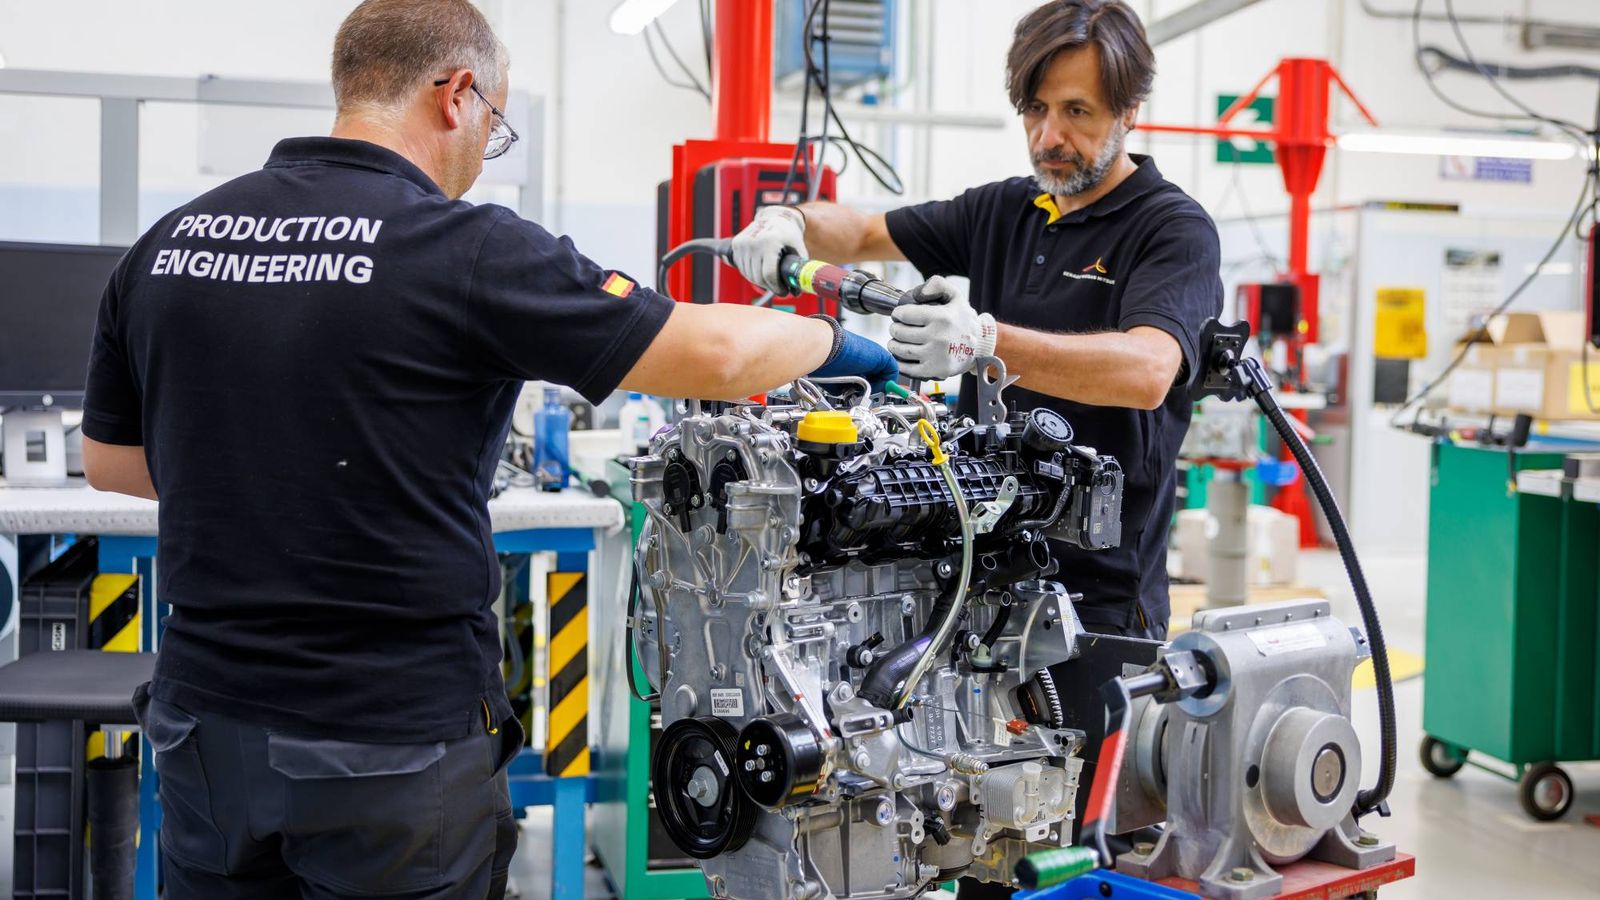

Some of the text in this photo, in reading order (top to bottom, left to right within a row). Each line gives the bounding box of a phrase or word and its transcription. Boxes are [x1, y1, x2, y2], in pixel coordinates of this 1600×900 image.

[171, 213, 383, 244] PRODUCTION
[150, 248, 374, 284] ENGINEERING
[948, 342, 975, 358] HyFlex
